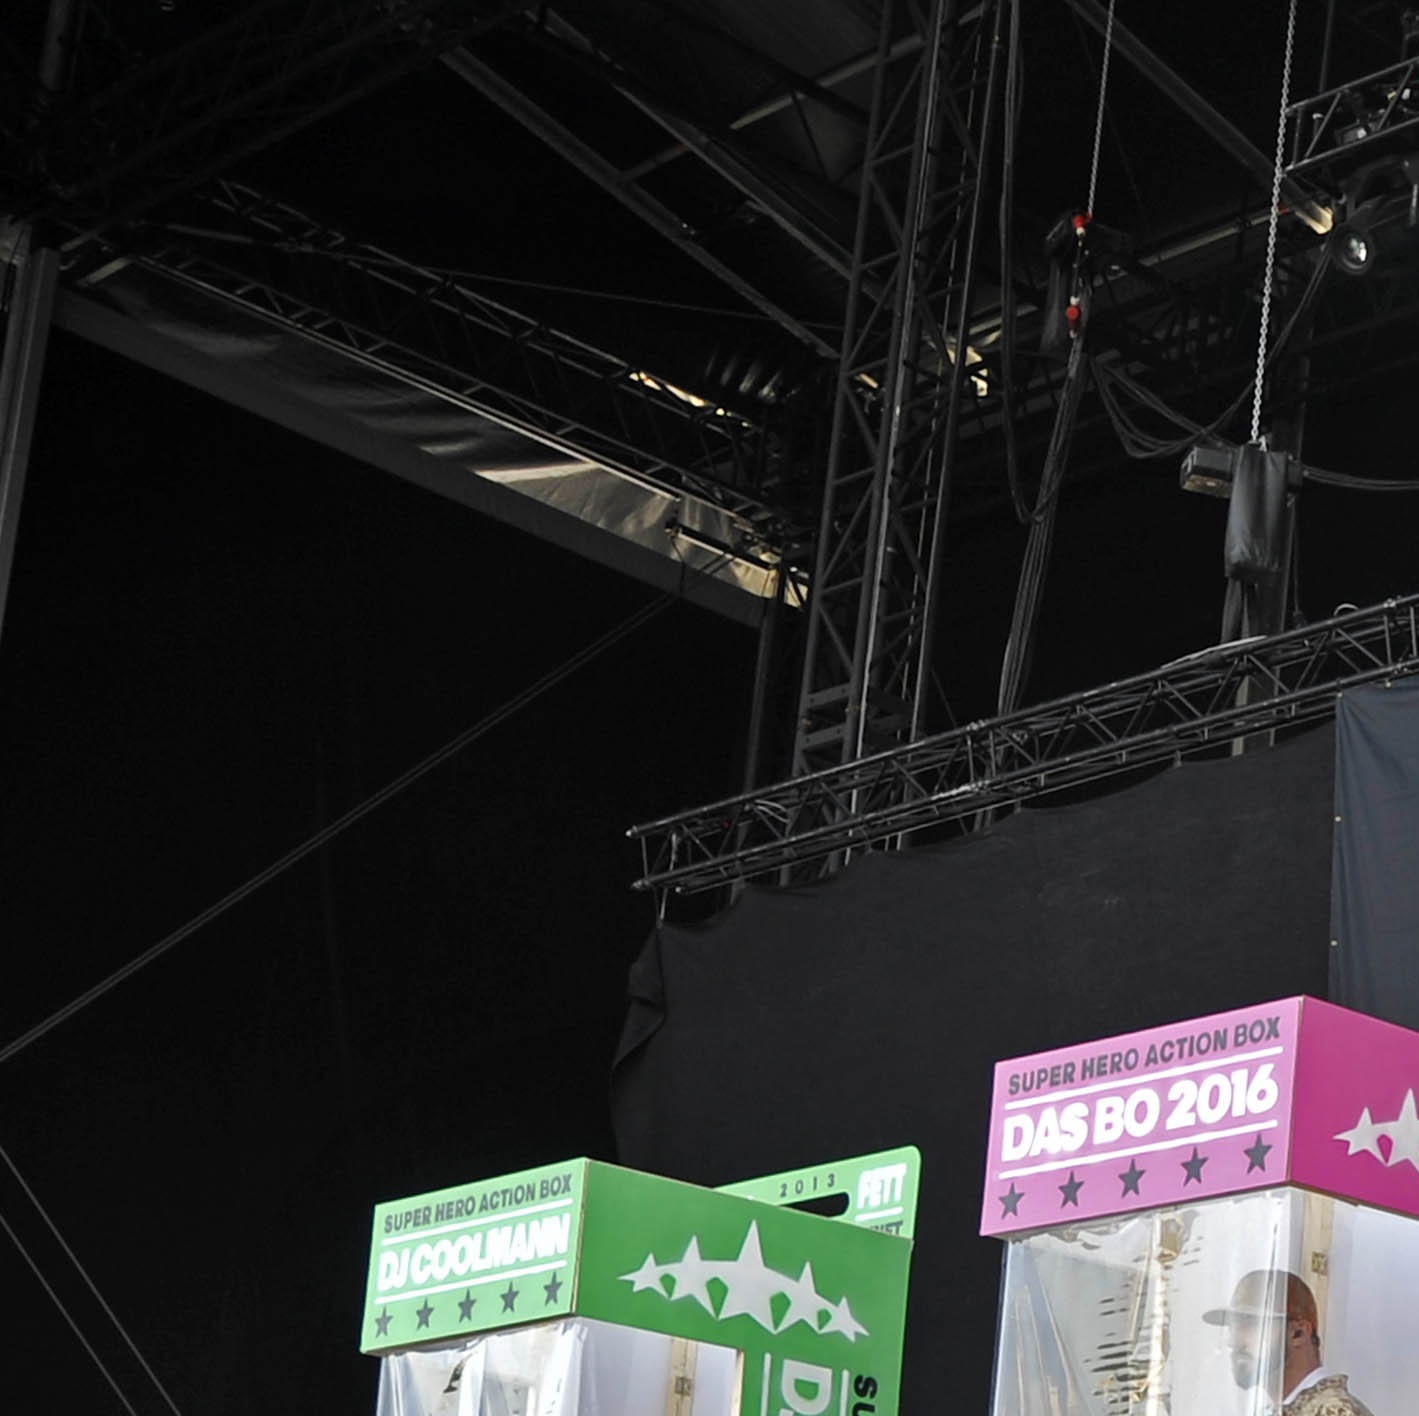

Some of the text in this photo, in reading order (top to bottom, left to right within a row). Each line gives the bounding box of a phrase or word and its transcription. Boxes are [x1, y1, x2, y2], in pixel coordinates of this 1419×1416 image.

[1008, 1017, 1280, 1096] SUPER HERO ACTION BOX
[1001, 1063, 1279, 1163] DAS BO 2016
[384, 1173, 572, 1233] SUPER HERO ACTION BOX
[780, 1173, 836, 1198] 2013
[377, 1213, 571, 1292] DJ COOLMANN
